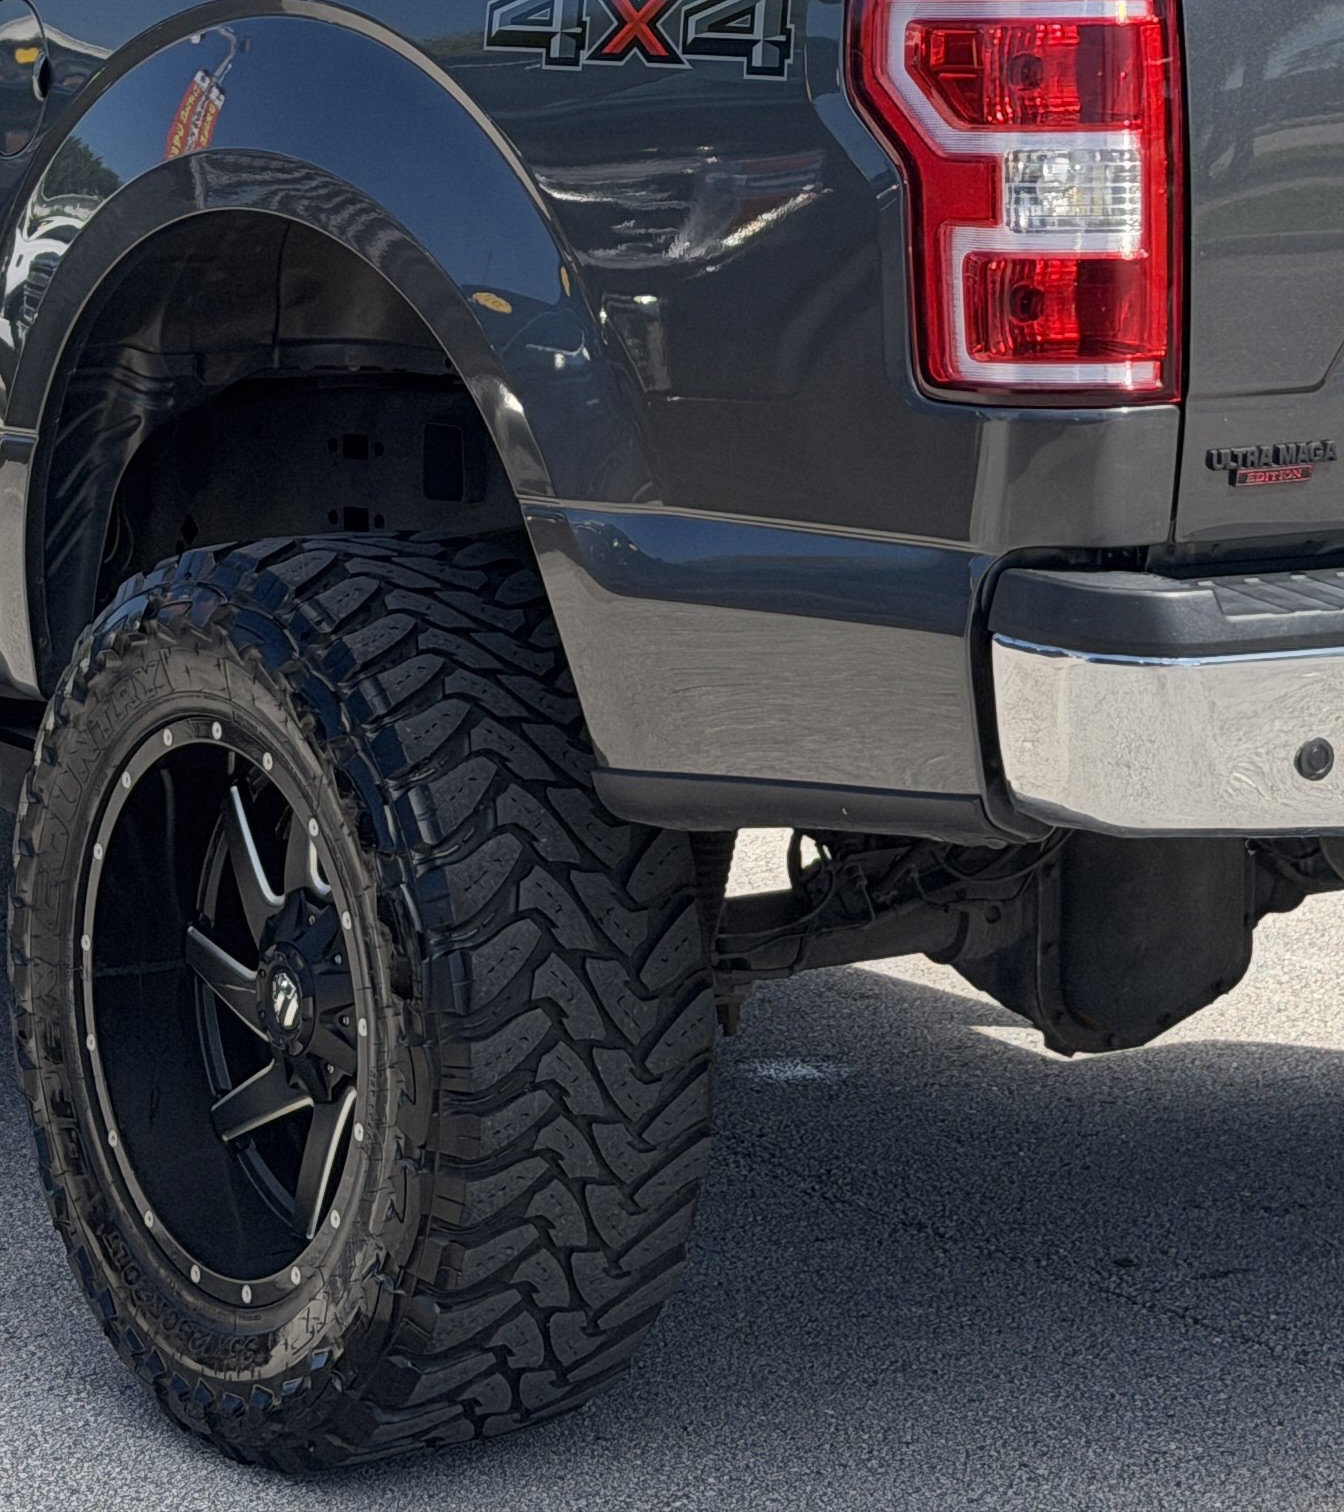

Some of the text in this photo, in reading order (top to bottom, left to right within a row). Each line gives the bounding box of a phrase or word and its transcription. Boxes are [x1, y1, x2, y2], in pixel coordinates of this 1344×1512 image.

[1206, 439, 1337, 470] ULTRA MAGA
[1246, 469, 1302, 482] EDITION
